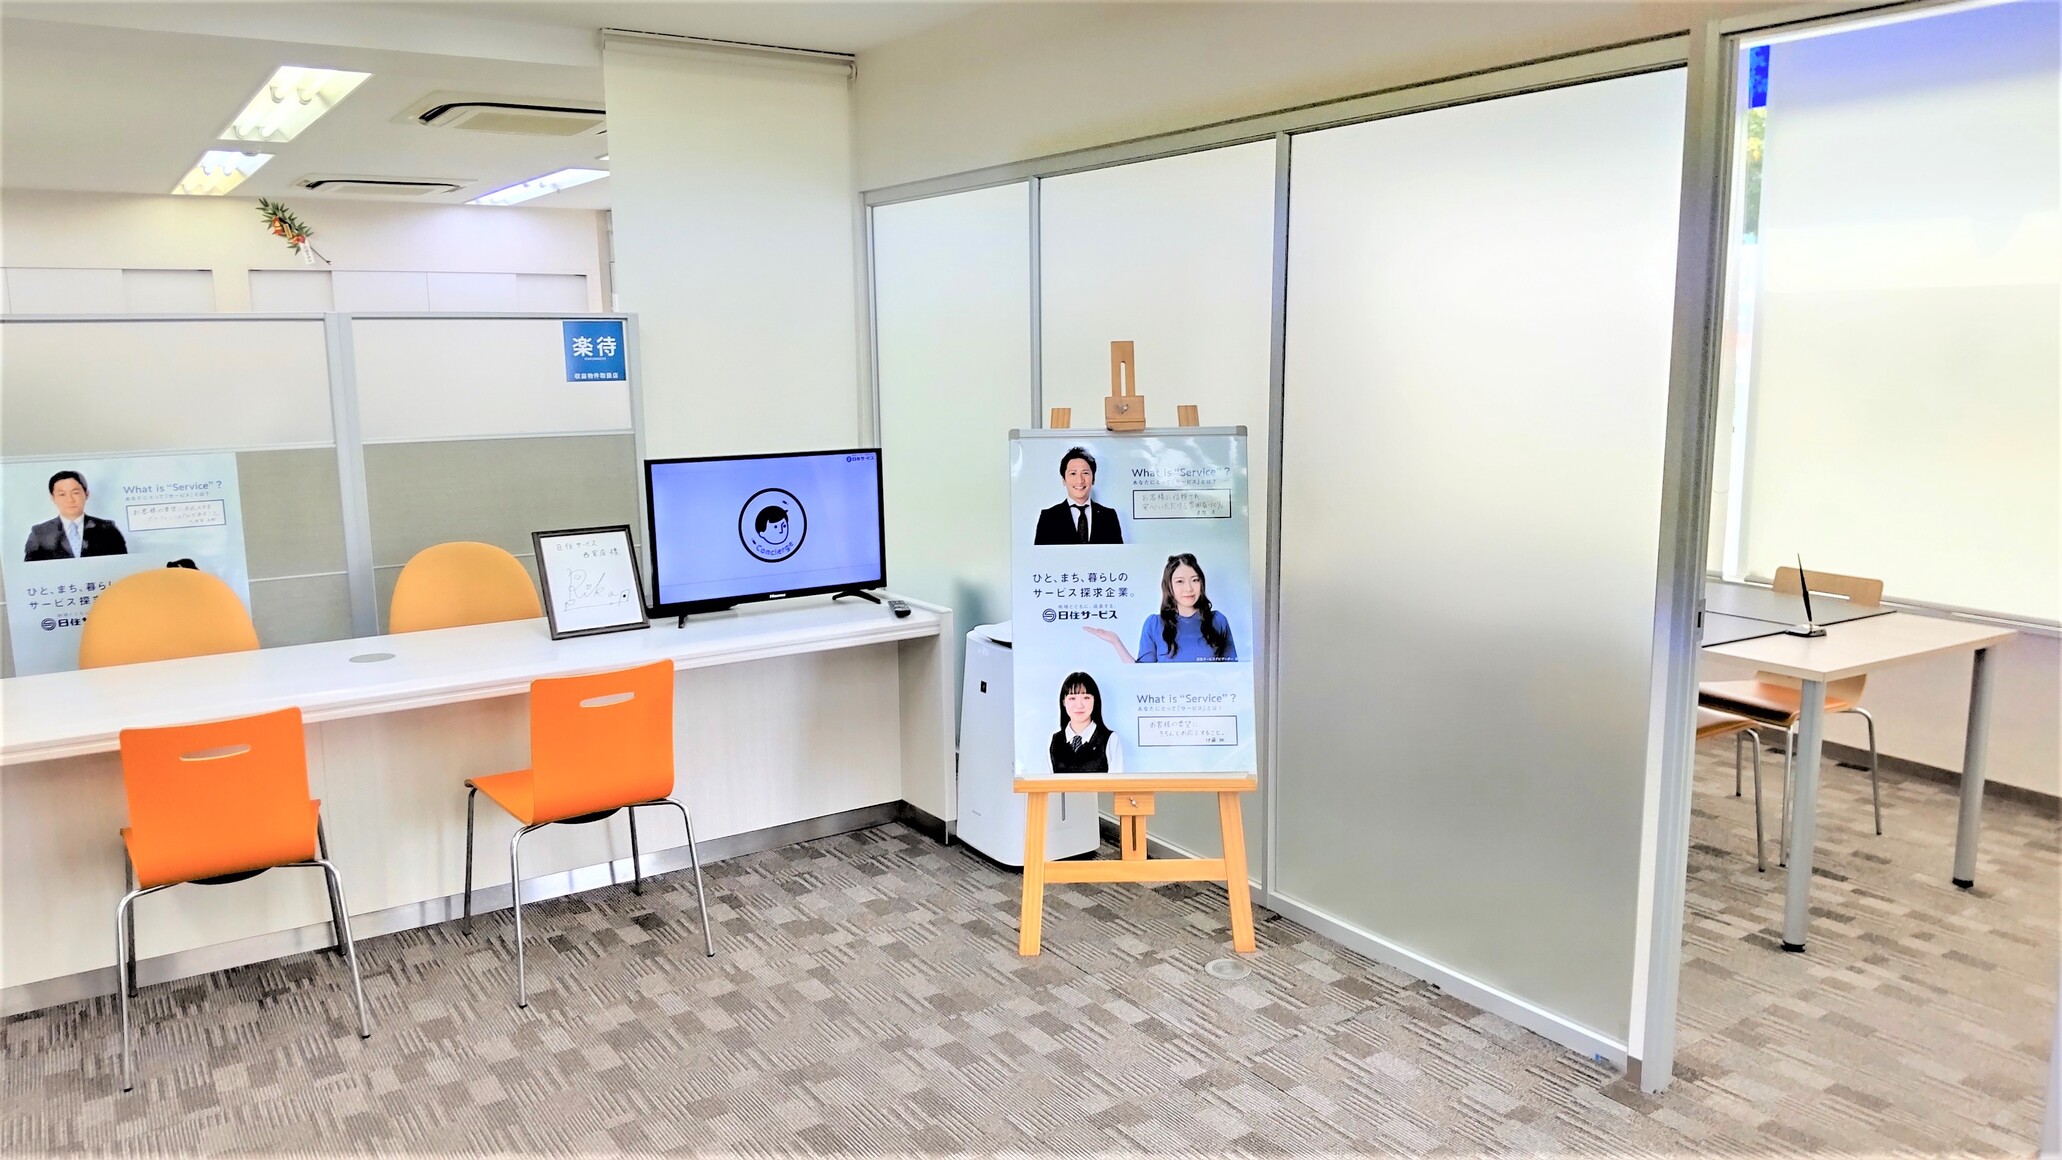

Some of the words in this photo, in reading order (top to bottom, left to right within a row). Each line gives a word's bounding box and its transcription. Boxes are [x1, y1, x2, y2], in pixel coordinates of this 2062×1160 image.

[572, 336, 617, 357] 楽待
[1131, 467, 1160, 478] What
[1163, 467, 1172, 477] is
[1223, 466, 1231, 476] ?
[123, 485, 153, 495] What
[156, 484, 165, 493] is
[216, 480, 222, 489] ?
[755, 541, 794, 556] Concierge
[1033, 572, 1128, 583] ひと、まち、暮らしの
[26, 581, 112, 596] ひと、まち、暮ら
[1033, 587, 1135, 598] サービス探求企業。
[1058, 610, 1118, 620] 日住サービス
[1136, 694, 1166, 704] What
[1169, 694, 1178, 703] is
[1230, 693, 1237, 703] ?
